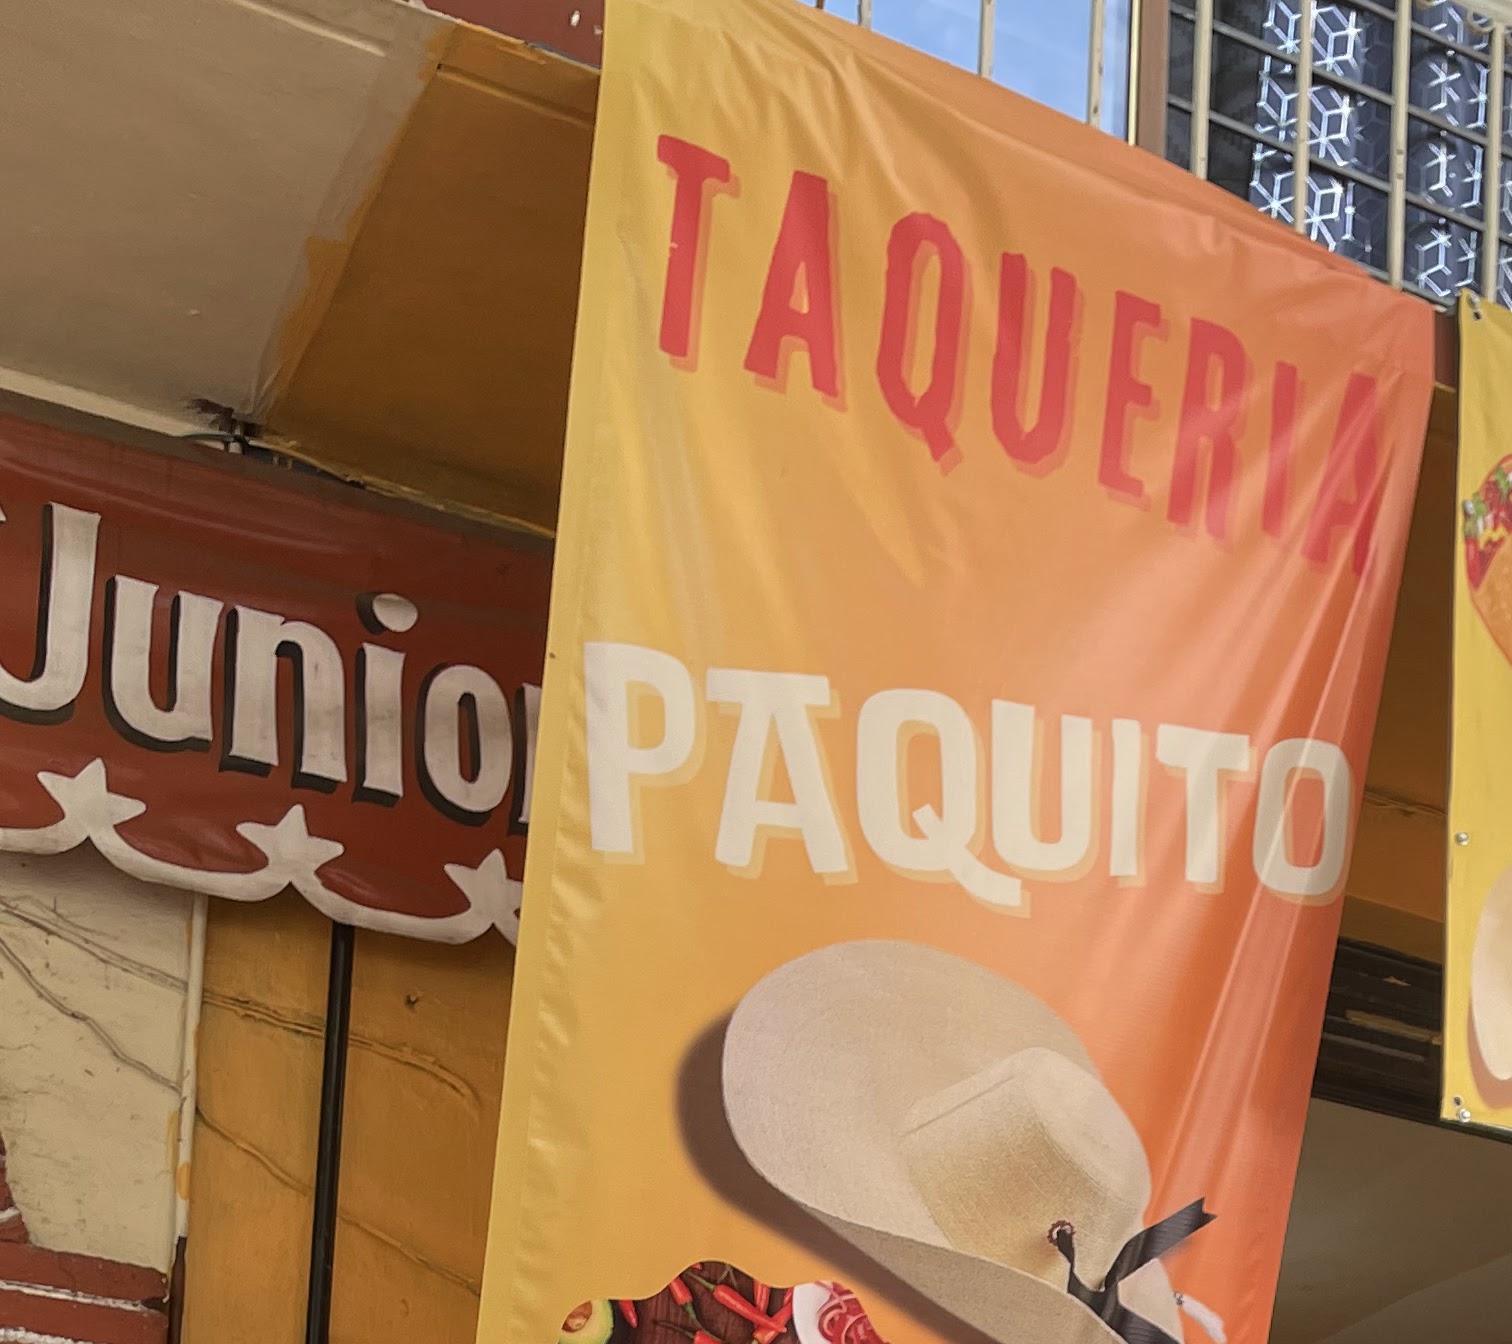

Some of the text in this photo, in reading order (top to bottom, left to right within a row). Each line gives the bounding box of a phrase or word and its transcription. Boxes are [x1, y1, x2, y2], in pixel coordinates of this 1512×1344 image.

[656, 132, 1390, 576] TAQUERIA
[0, 502, 541, 828] Junio
[583, 640, 1357, 912] PAQUITO
